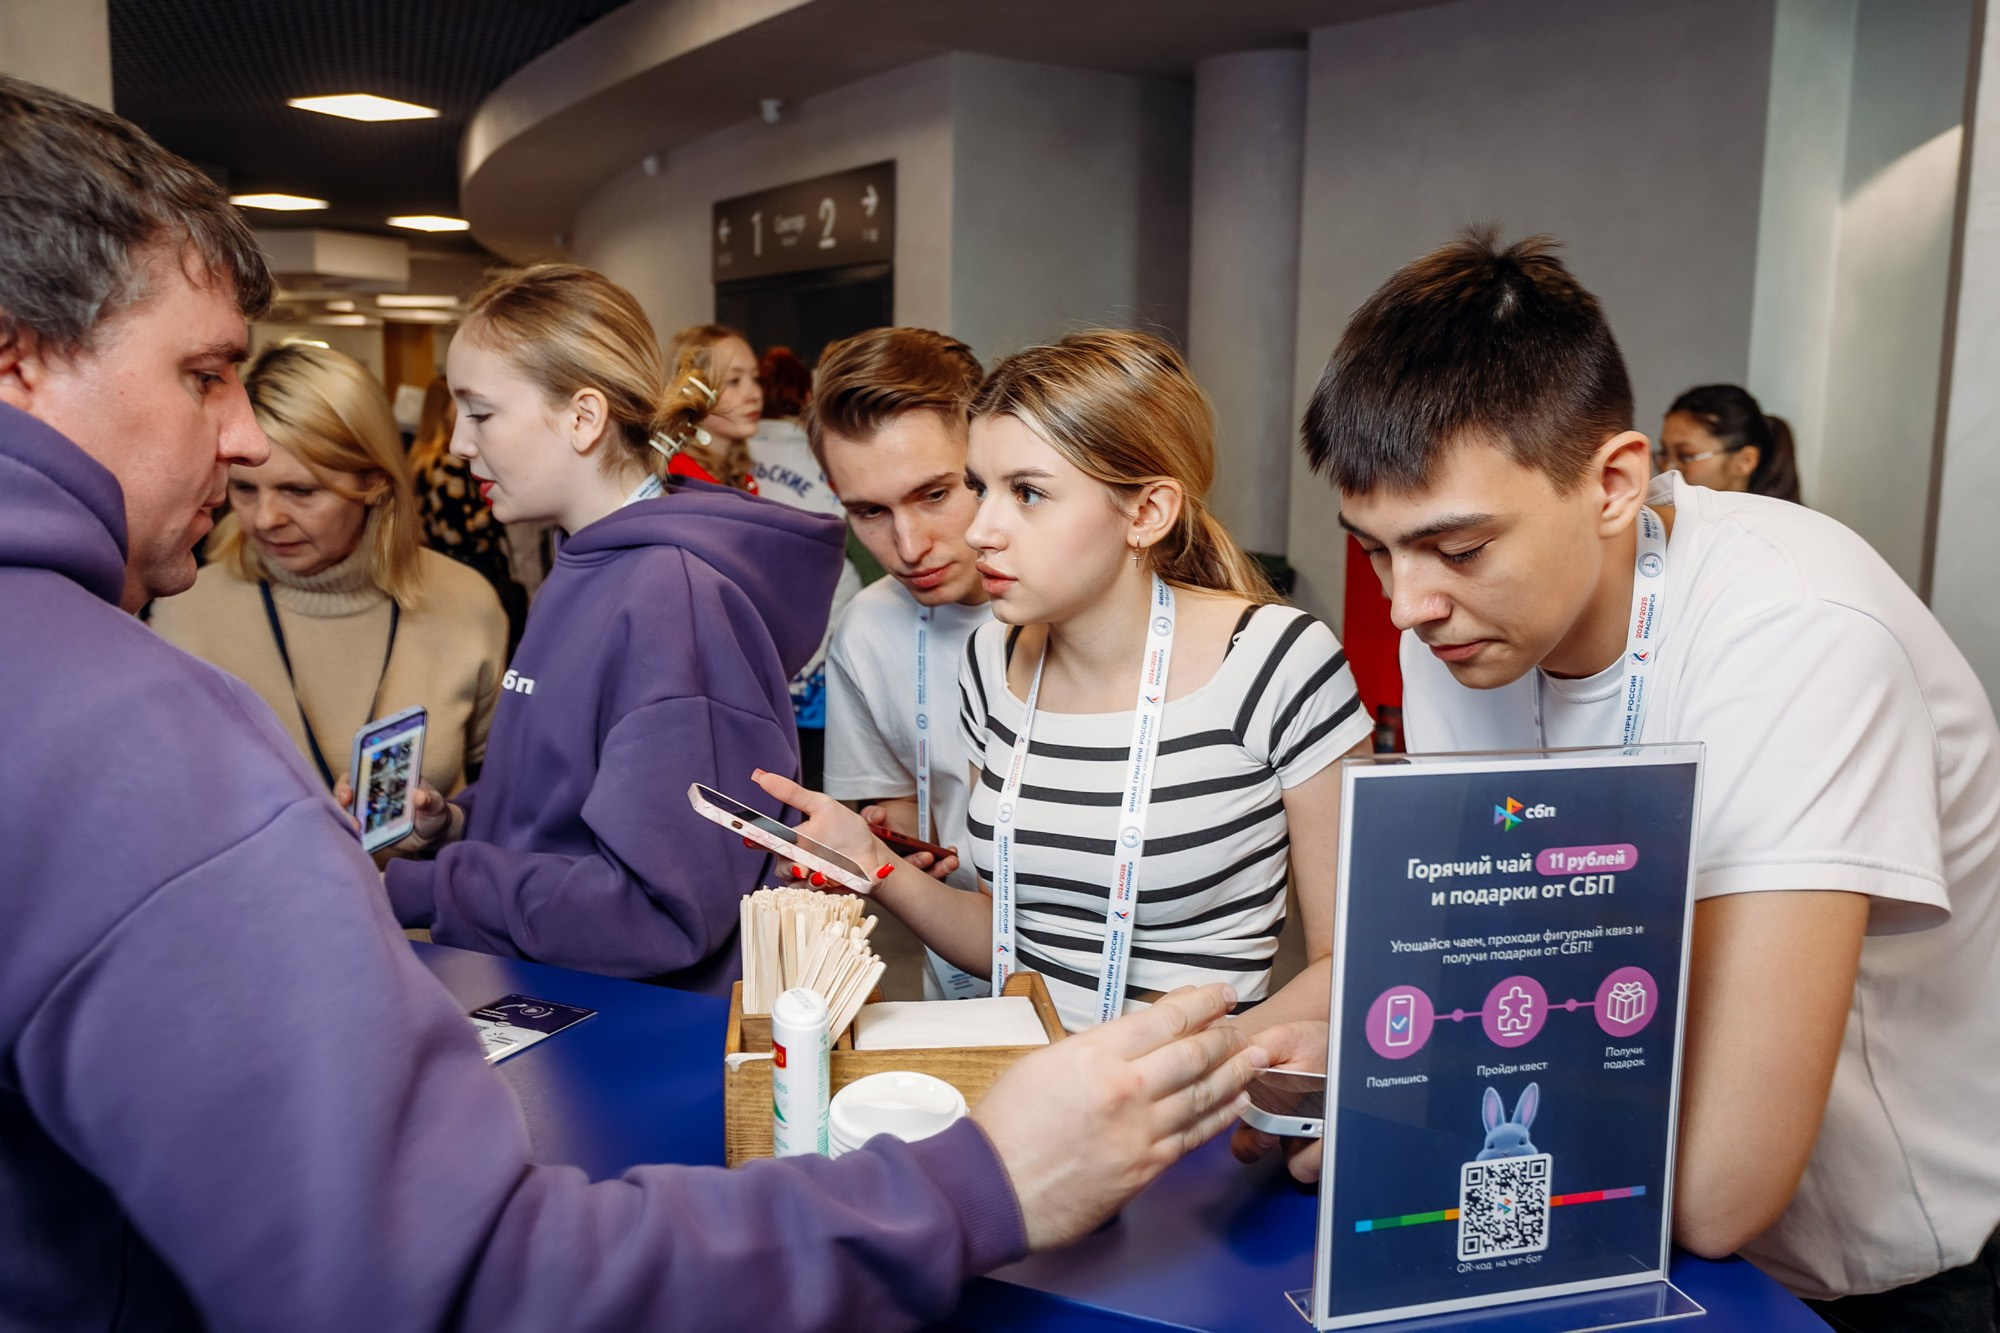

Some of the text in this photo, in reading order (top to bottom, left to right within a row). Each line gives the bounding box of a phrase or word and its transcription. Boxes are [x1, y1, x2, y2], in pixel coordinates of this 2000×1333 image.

[751, 211, 763, 258] 1
[818, 197, 838, 250] 2
[755, 462, 814, 498] ЬСКИЕ
[1635, 597, 1648, 640] 2024/2025
[1643, 593, 1656, 640] КРАСНОЯРСК
[502, 668, 535, 695] бп
[1147, 651, 1159, 685] 2024/2025
[1155, 648, 1165, 686] КРАСНОЯРСК
[1626, 675, 1638, 711] РОССИИ
[1629, 713, 1639, 741] катанию
[1636, 675, 1645, 702] коньках
[1128, 714, 1149, 813] ФИНАЛ ГРАН-ПРИ РОССИИ
[1525, 803, 1556, 819] сбп
[1117, 863, 1127, 900] 2024/2025
[1124, 861, 1134, 901] КРАСНОЯРСК
[1407, 849, 1626, 882] Горячий чай 11 рублей
[1431, 875, 1616, 906] и подарки от СБП
[1390, 925, 1644, 953] Угощайся чаем, проходи фигурный квиз и
[1442, 941, 1594, 965] получи подарки от СБП!
[1100, 930, 1119, 1025] ИНАЛ ГРАН-ПРИ РОССИИ
[1603, 1057, 1645, 1071] подарок
[1605, 1045, 1643, 1059] Получи
[1366, 1073, 1428, 1088] Подпишись
[1477, 1061, 1548, 1078] Пройди квест
[1457, 1254, 1543, 1273] QR-код на чат-бот
